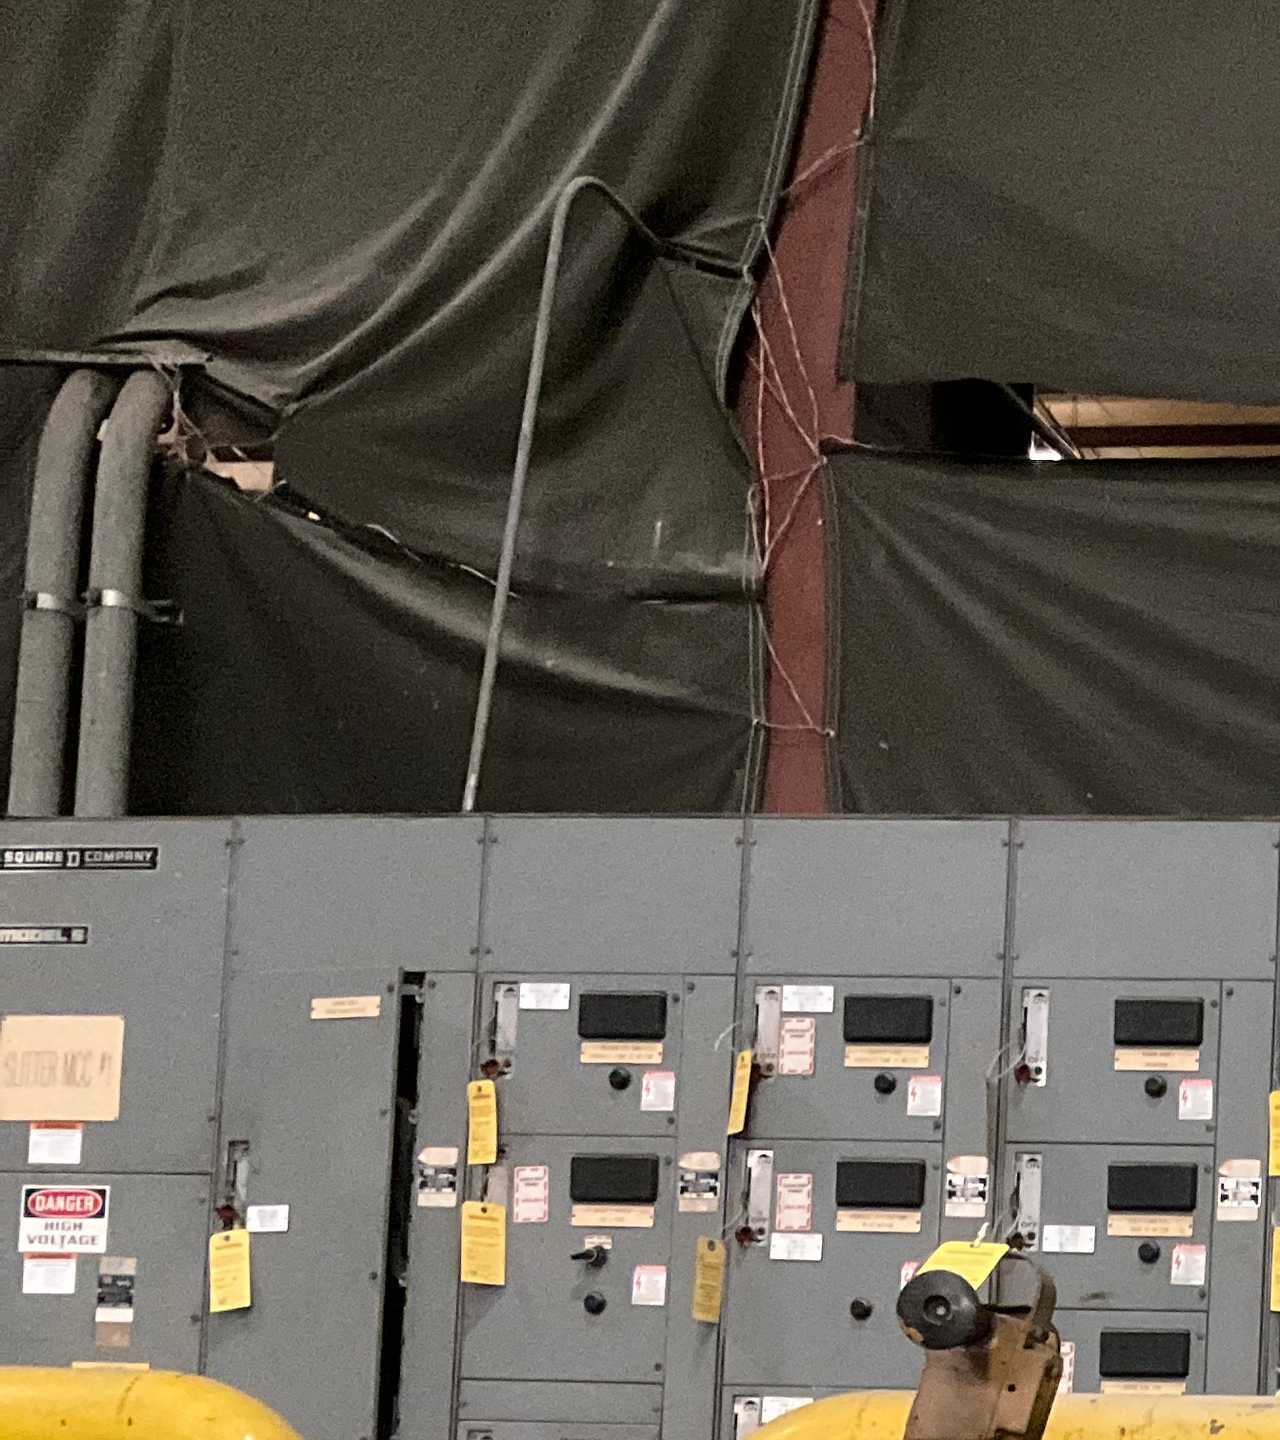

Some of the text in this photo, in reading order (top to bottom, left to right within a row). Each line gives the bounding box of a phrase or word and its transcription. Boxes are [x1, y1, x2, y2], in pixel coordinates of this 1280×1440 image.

[4, 851, 154, 867] SQUARE D COMPANY
[34, 1195, 95, 1212] DANGER
[44, 1221, 83, 1231] HIGH
[26, 1234, 100, 1247] VOLTAGE
